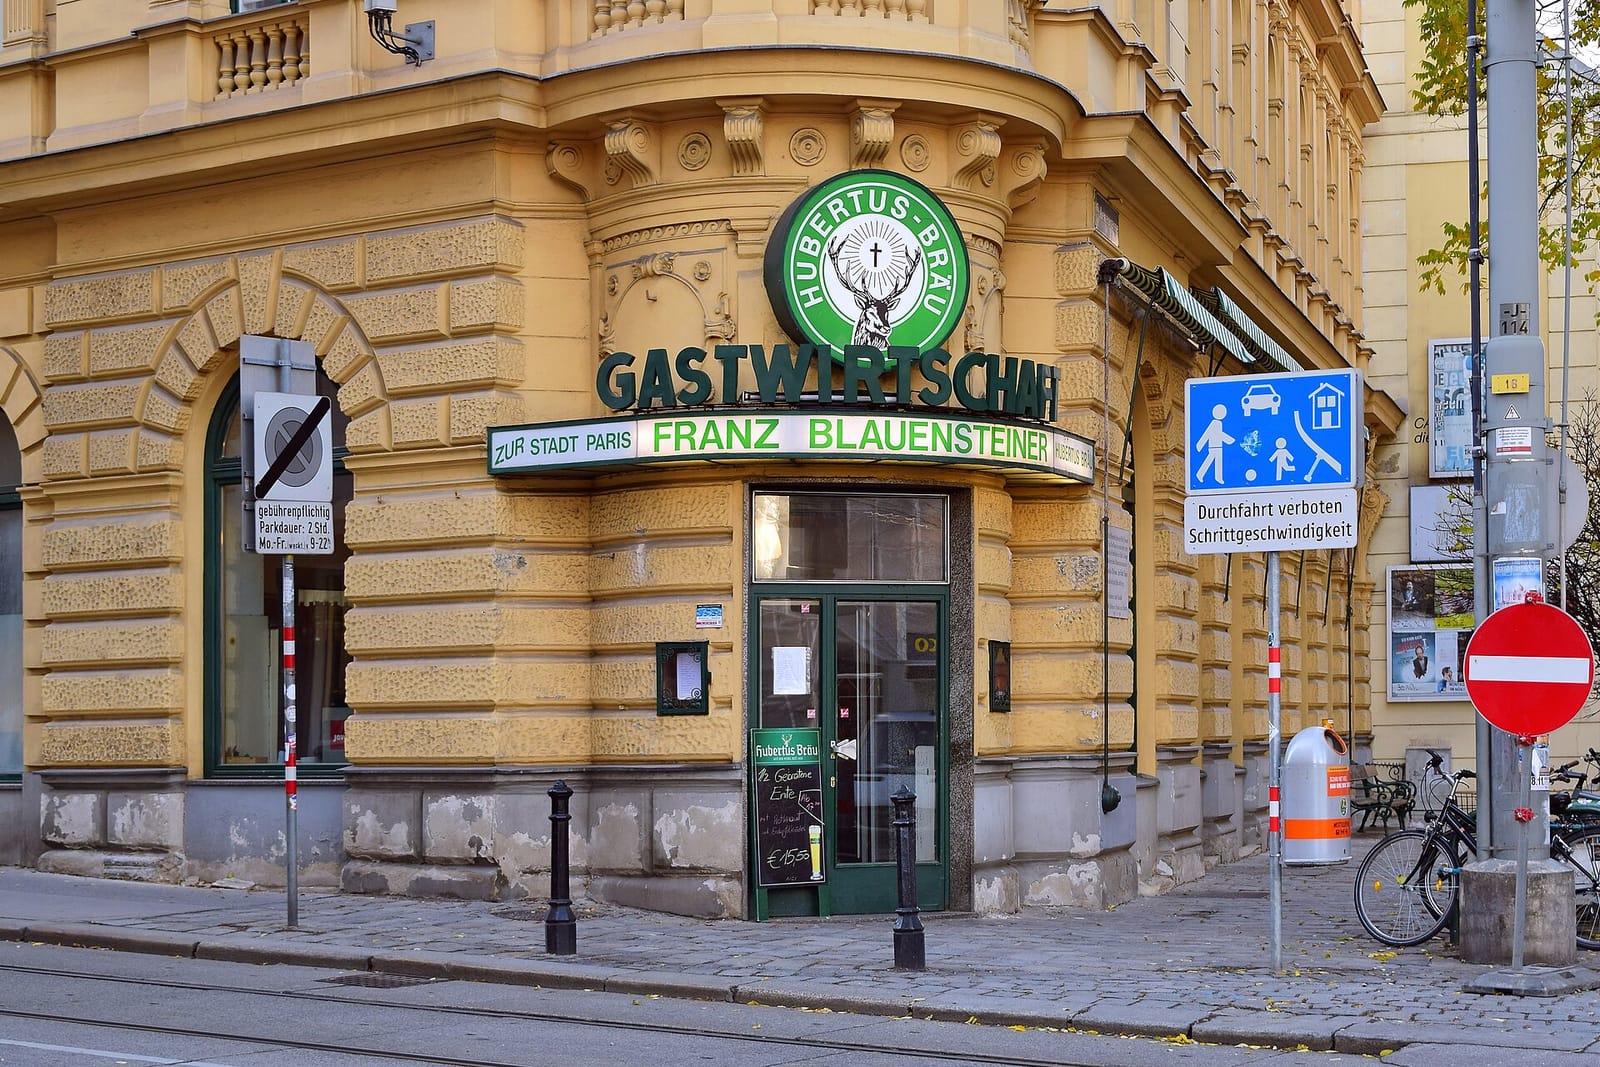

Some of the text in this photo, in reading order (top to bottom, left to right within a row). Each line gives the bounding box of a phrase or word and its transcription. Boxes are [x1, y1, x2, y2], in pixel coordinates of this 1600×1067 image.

[796, 189, 952, 316] HUBERTUS-BRÄU
[1502, 320, 1528, 334] 114
[596, 344, 1061, 422] GASTWIRTSCHAFT
[494, 431, 632, 466] ZUR STADT PARIS
[653, 418, 1048, 463] FRANZ BLAUENSTEINER
[1055, 442, 1080, 465] HUBERTUS
[258, 504, 330, 520] gebührenpflichtig
[1198, 500, 1343, 520] Durchfahrt verboten
[260, 521, 330, 534] Parkdauer: 2 Std.
[1189, 521, 1353, 545] Schrittgeschwindigkeit
[796, 743, 818, 756] Bräu
[770, 785, 797, 800] Ente
